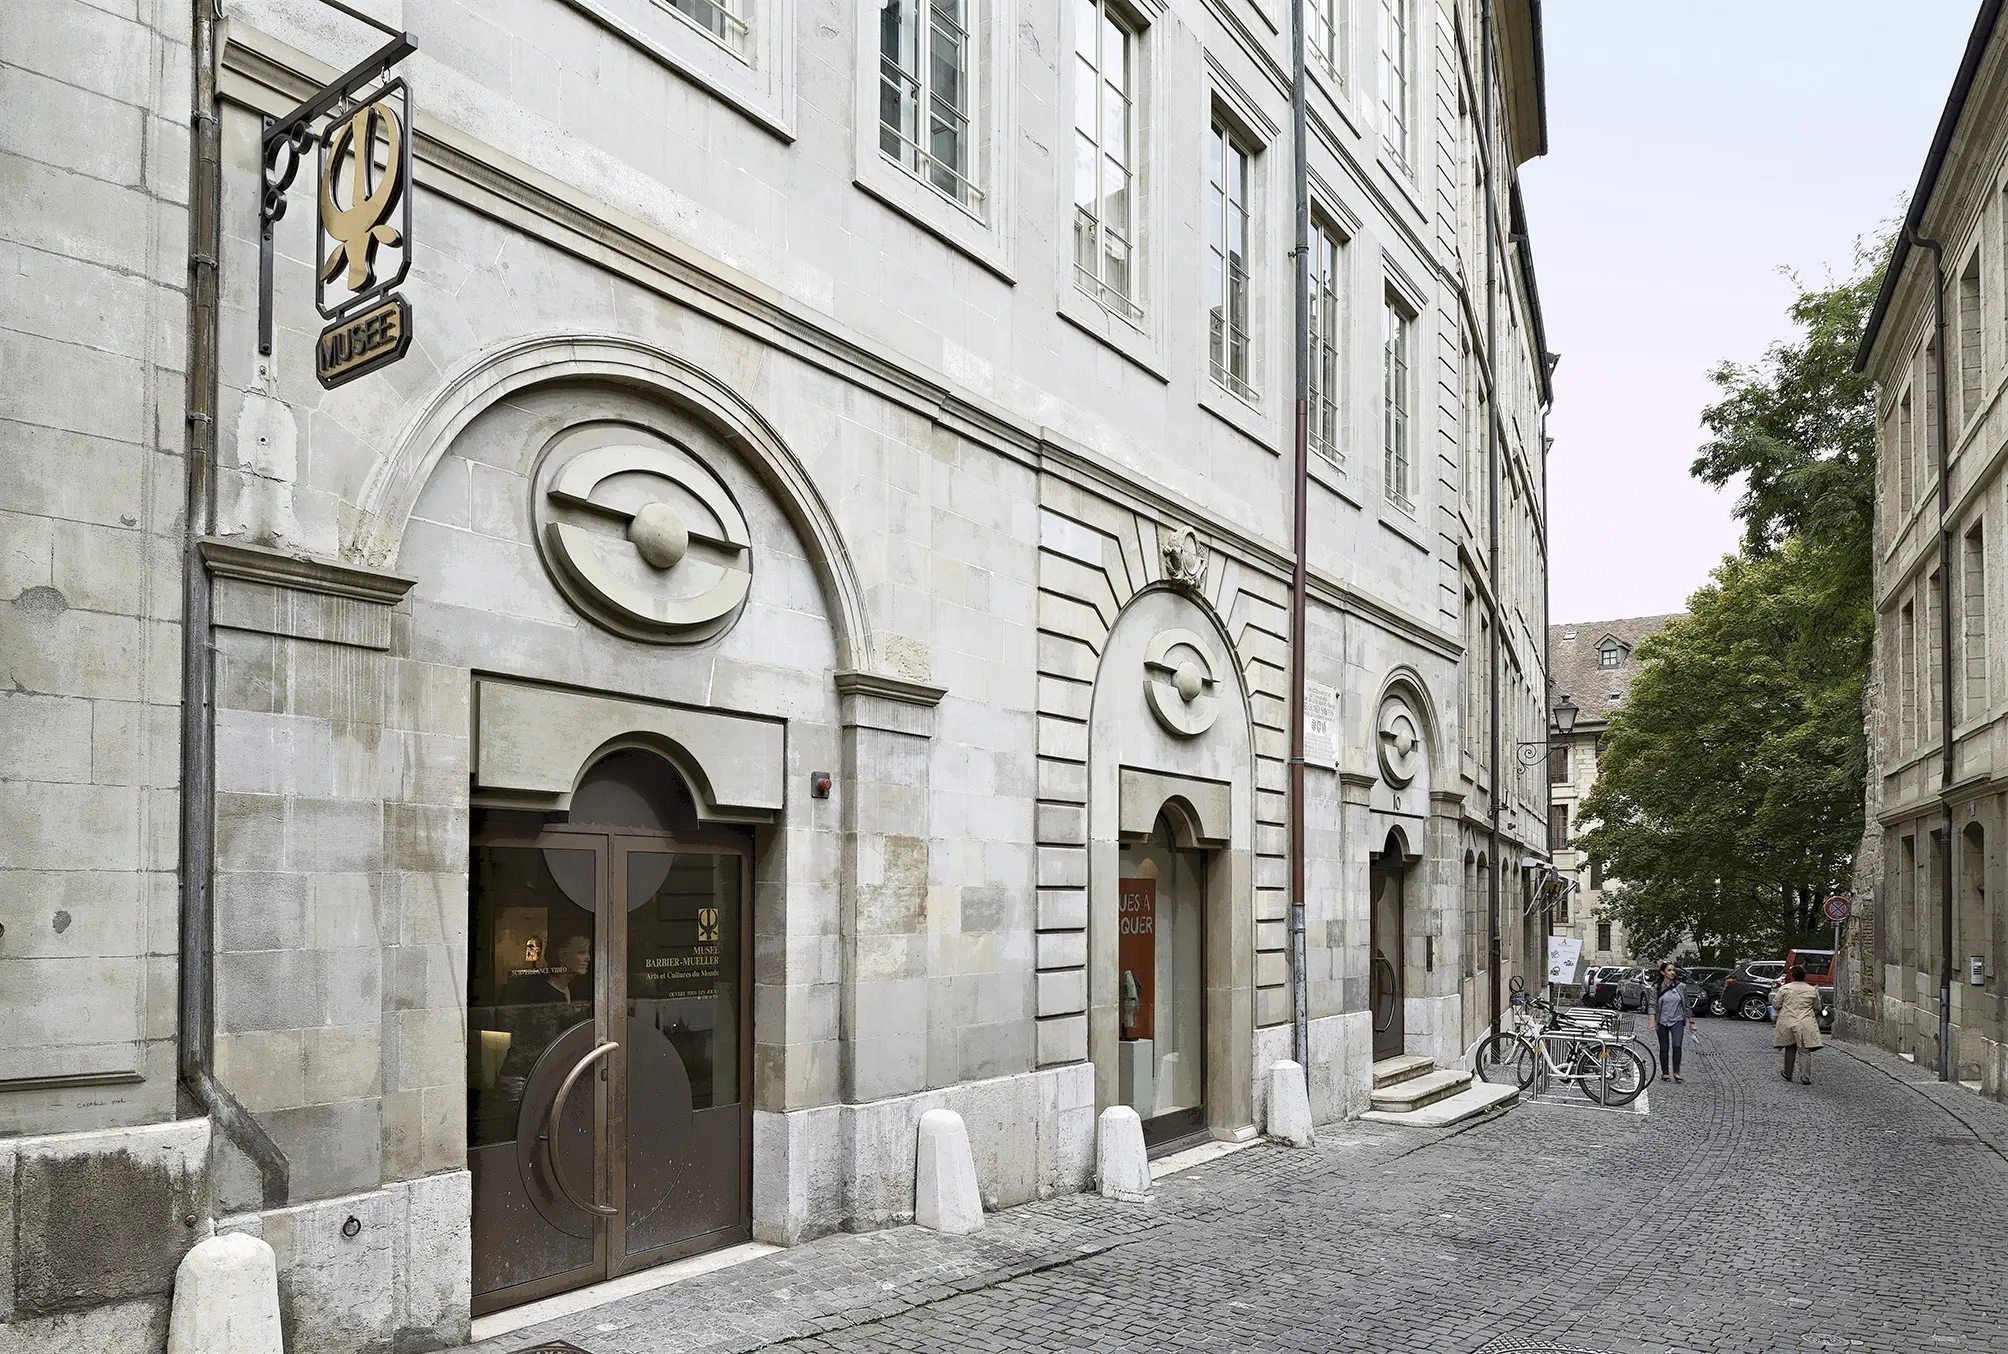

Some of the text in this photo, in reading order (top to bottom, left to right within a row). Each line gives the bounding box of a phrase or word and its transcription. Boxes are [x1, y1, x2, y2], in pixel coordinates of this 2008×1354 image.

[320, 309, 398, 371] MUSEE
[1393, 793, 1401, 810] 10
[1143, 889, 1150, 911] À
[646, 956, 719, 967] BARBIER-MUELLER
[667, 971, 691, 979] Cultures
